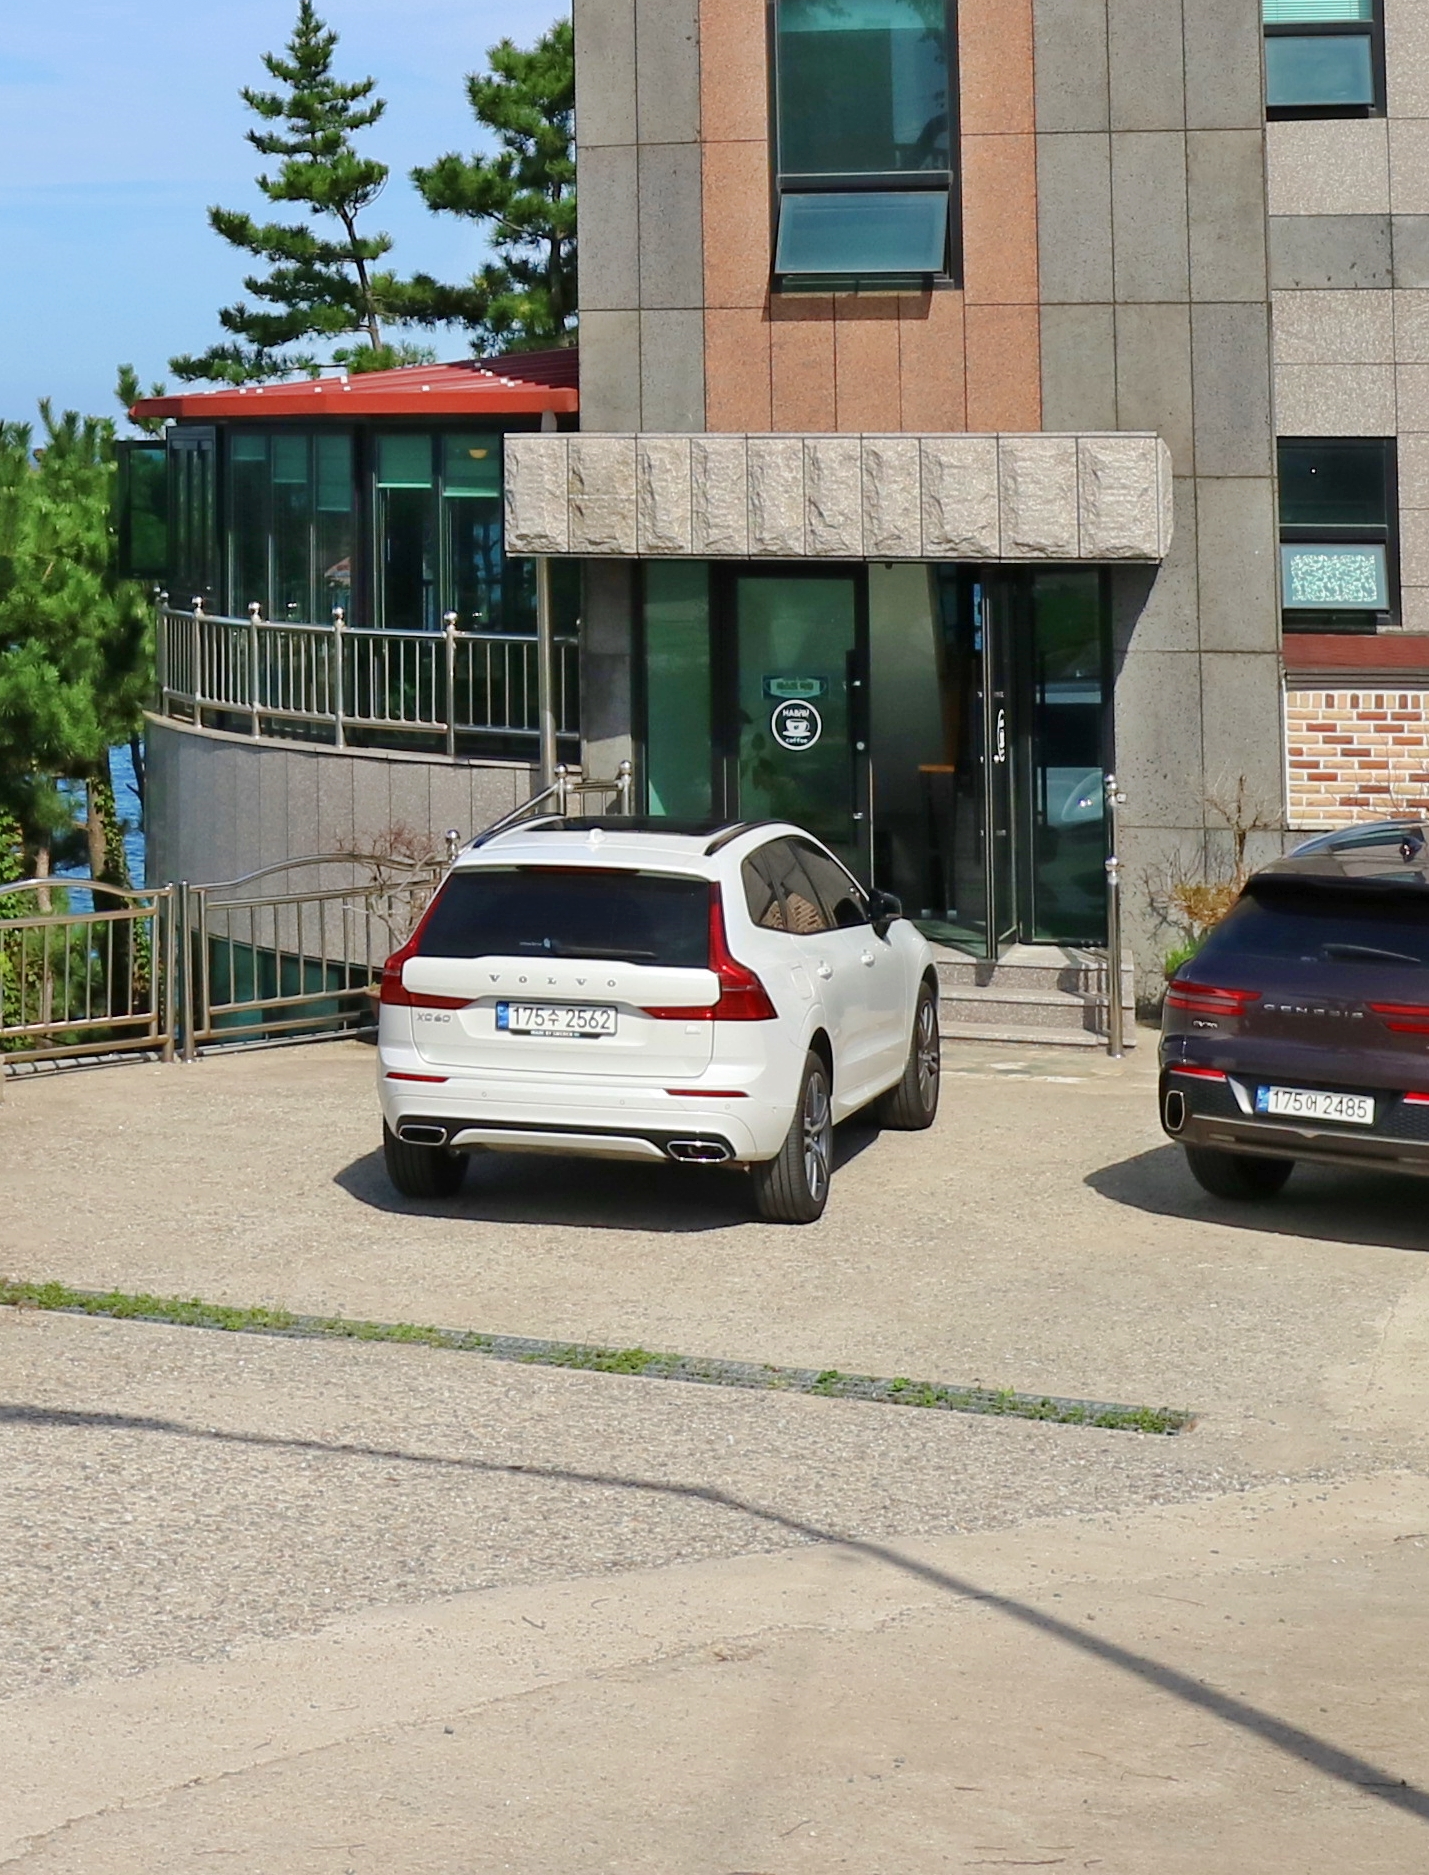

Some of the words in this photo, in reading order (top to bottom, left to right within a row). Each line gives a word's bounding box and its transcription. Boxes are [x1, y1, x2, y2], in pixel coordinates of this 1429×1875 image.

[782, 708, 810, 719] HABIBI
[489, 974, 617, 988] VOLVO
[417, 1012, 451, 1023] XC60
[513, 1006, 559, 1027] 175수
[565, 1008, 611, 1030] 2562
[1263, 1004, 1364, 1019] GENESIS
[1322, 1095, 1367, 1119] 2485
